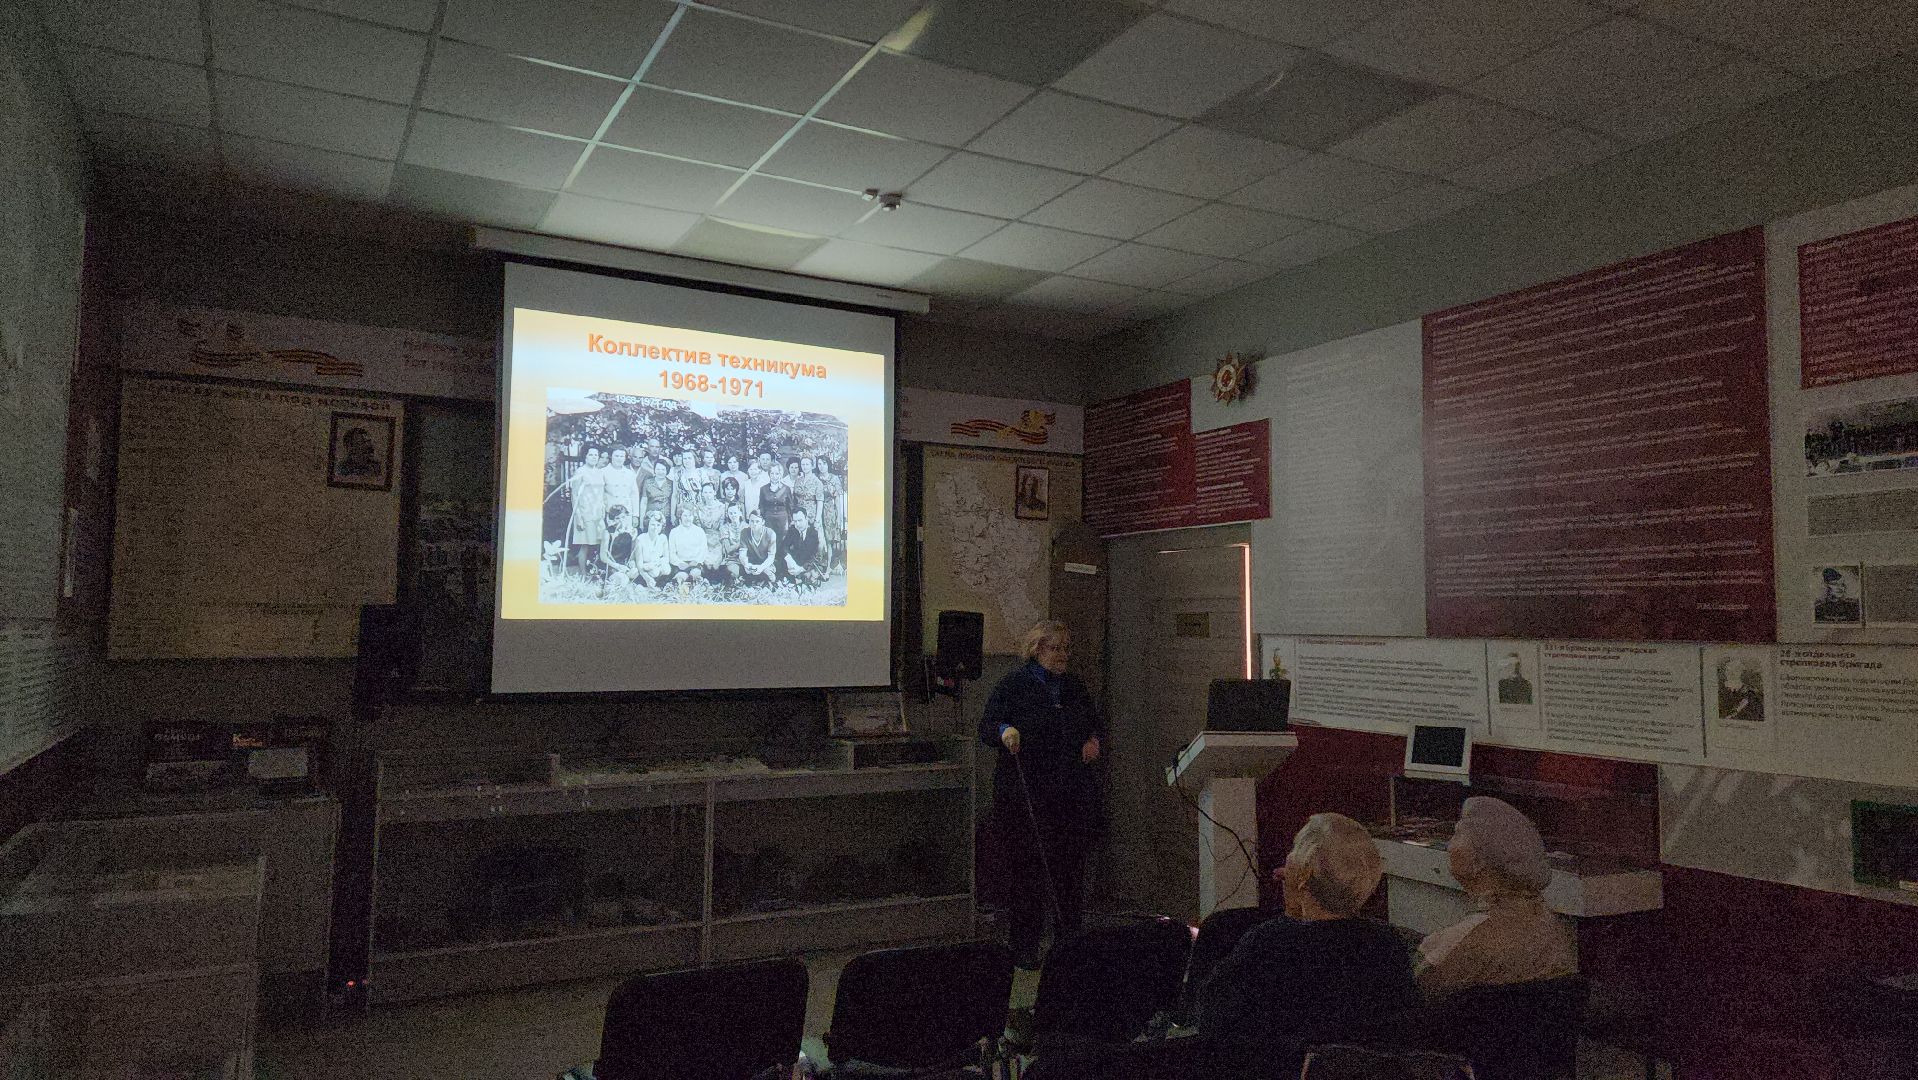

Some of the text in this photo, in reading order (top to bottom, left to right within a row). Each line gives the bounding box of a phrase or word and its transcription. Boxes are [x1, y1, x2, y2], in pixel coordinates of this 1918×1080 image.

[588, 333, 828, 380] Коллектив техникума
[658, 370, 763, 399] 1968-1971
[1839, 660, 1883, 670] бригада
